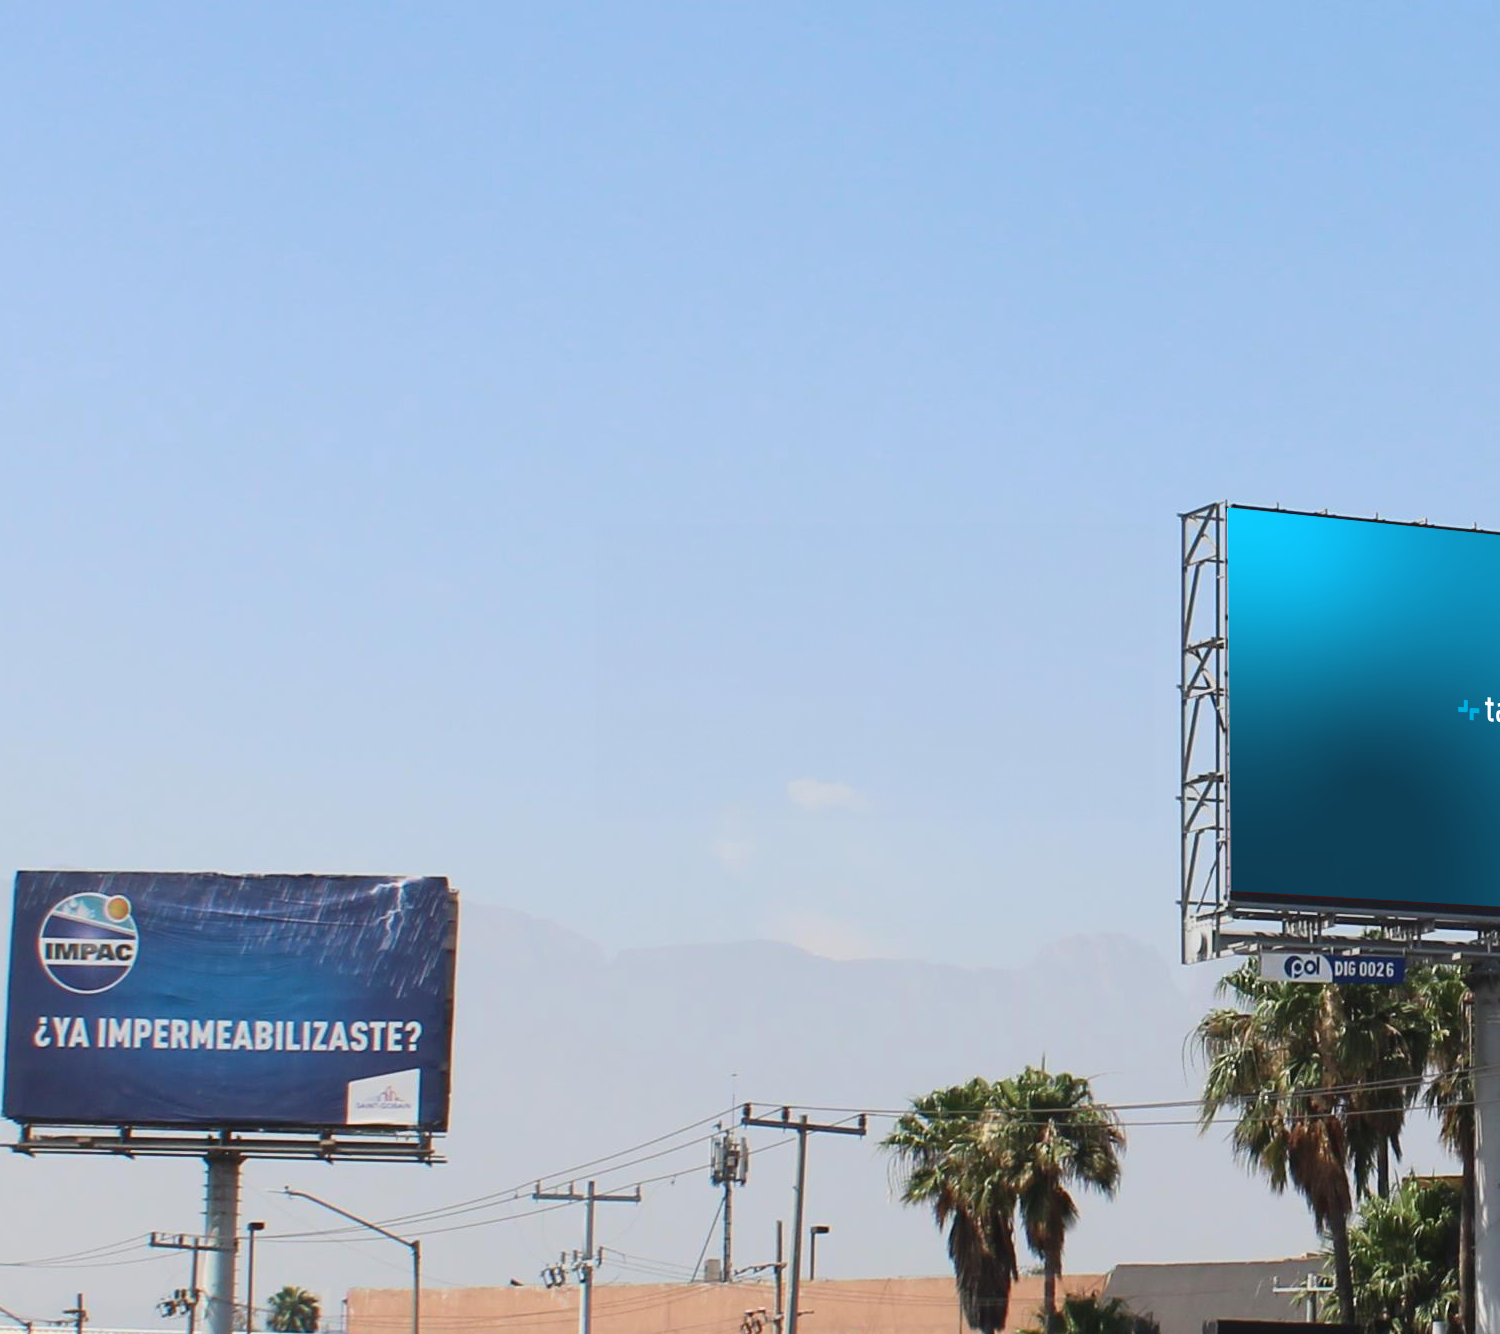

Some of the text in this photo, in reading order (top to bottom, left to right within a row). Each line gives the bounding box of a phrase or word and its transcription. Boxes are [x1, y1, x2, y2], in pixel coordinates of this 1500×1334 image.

[45, 943, 133, 961] IMPAC
[1335, 961, 1356, 977] DIG
[1359, 961, 1395, 977] 0026
[34, 1017, 422, 1052] ¿YA IMPERMEABILIZASTE?
